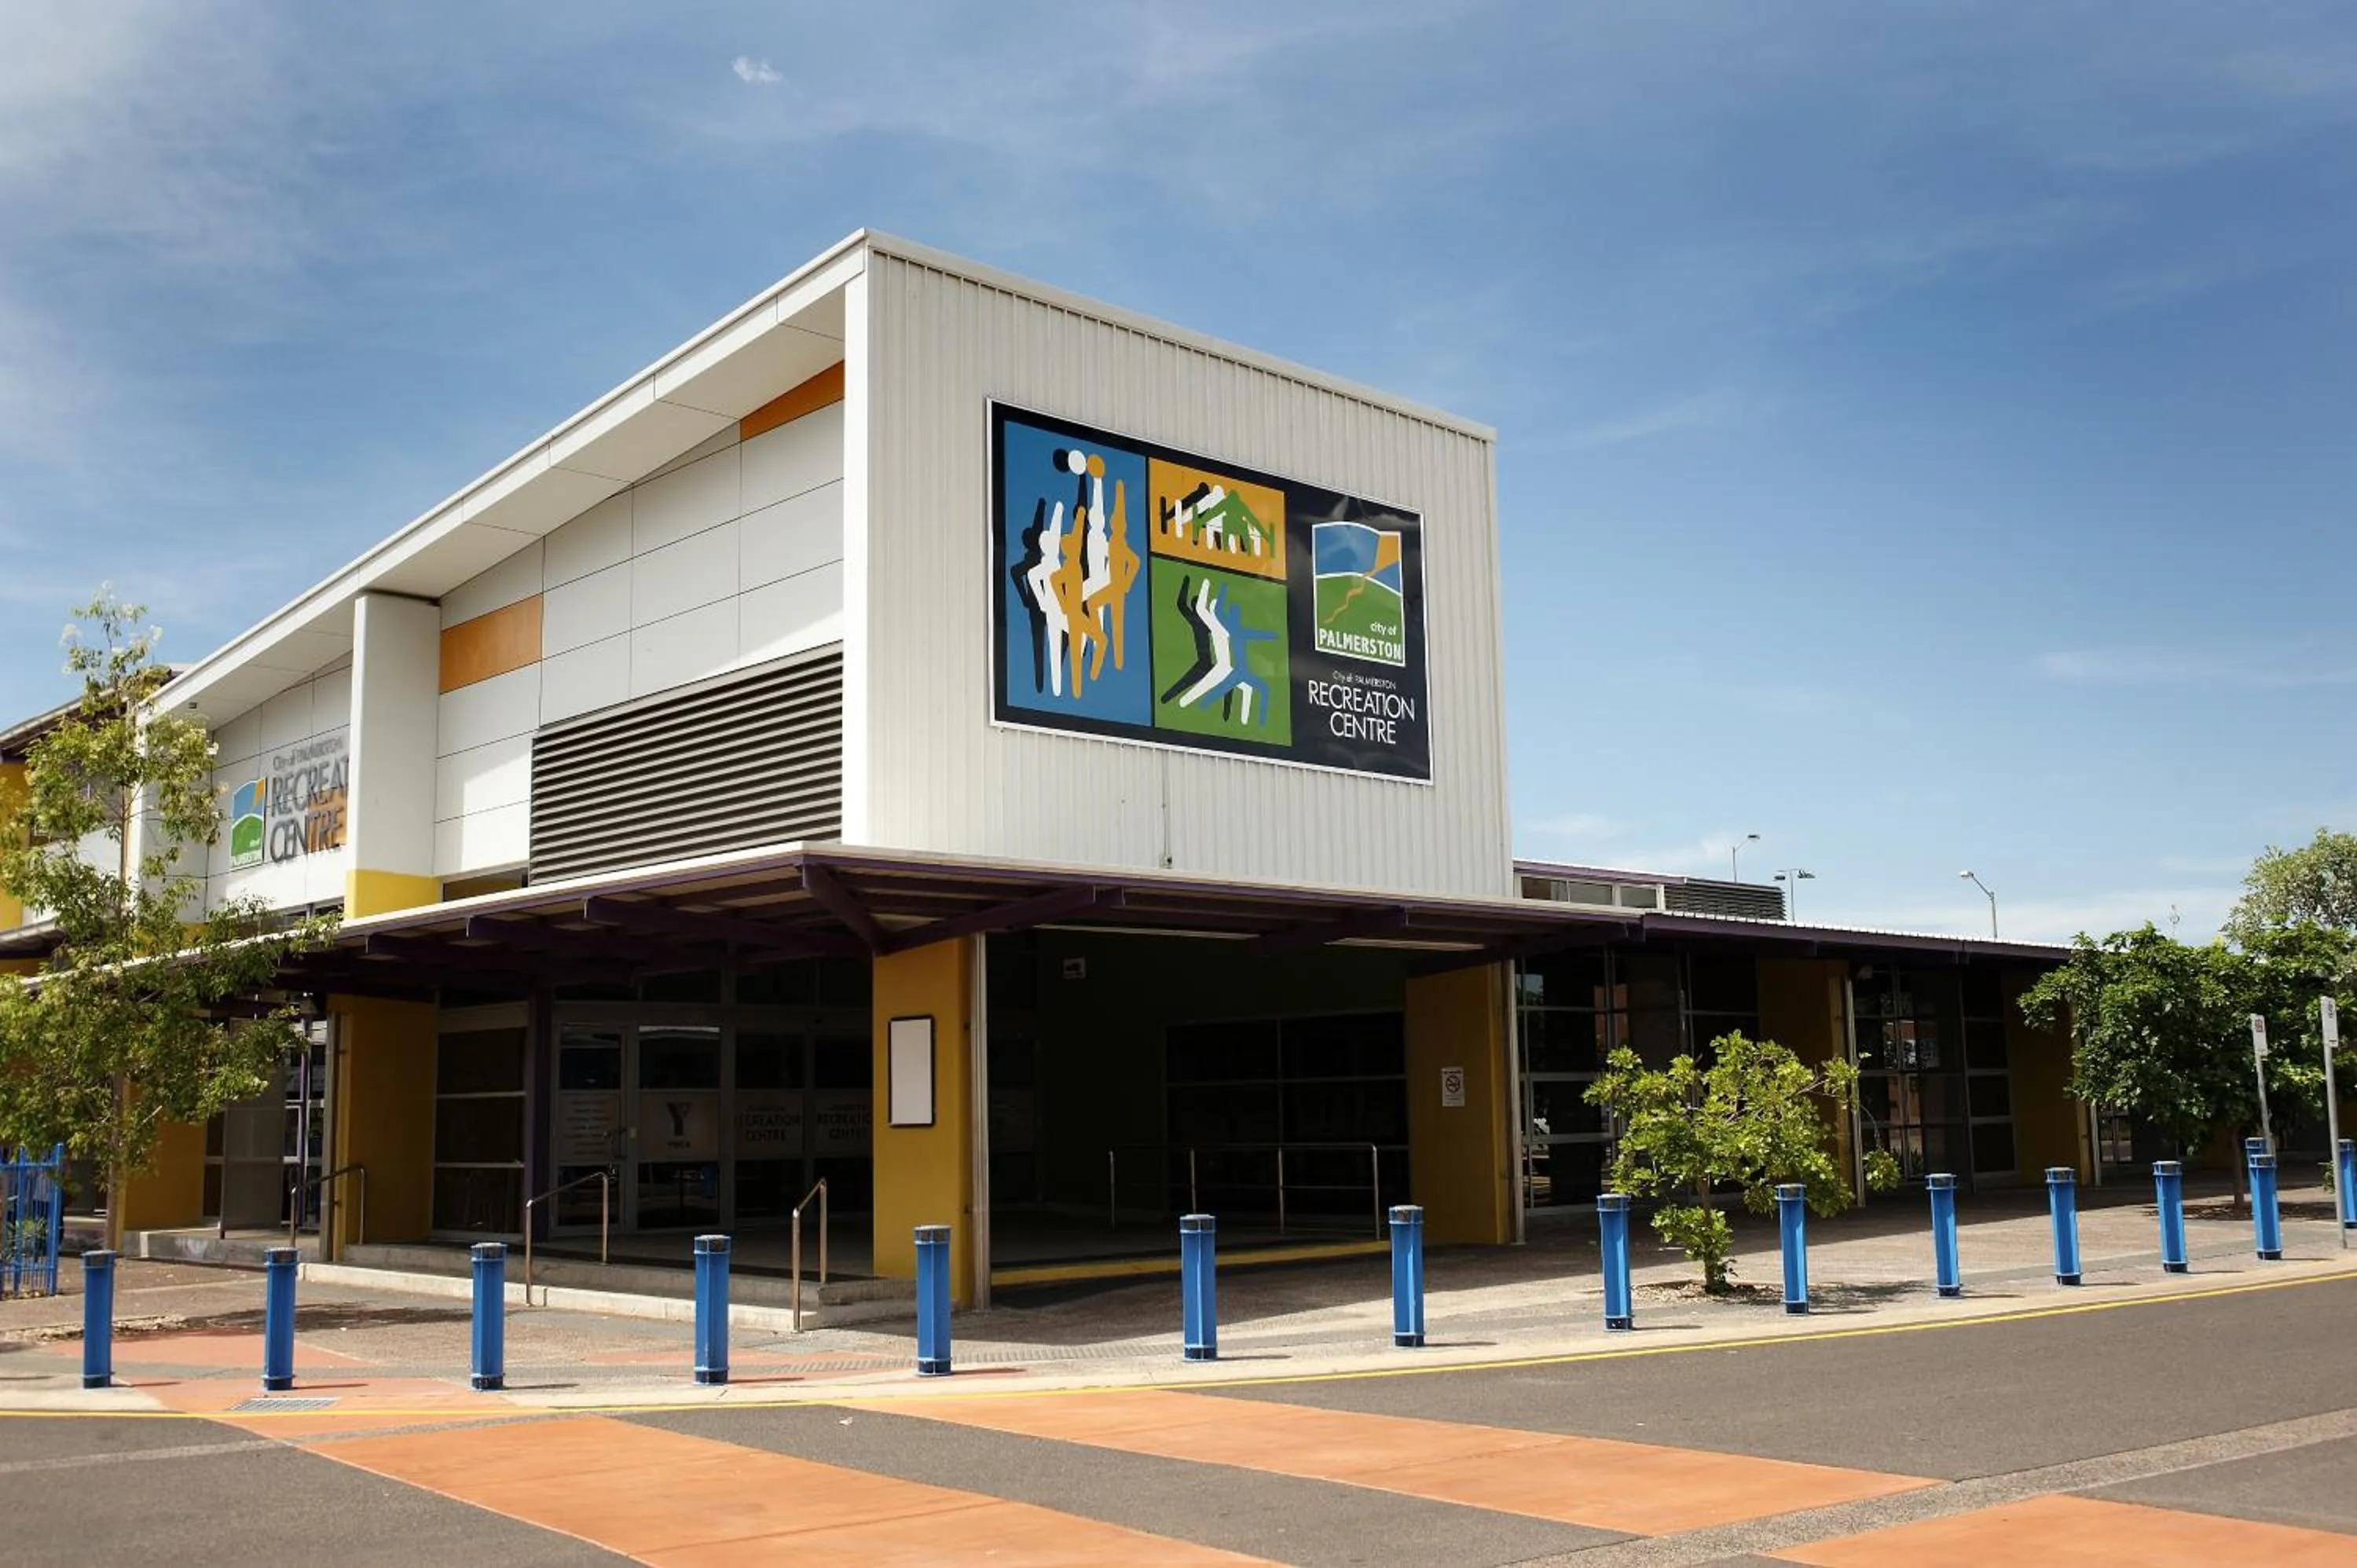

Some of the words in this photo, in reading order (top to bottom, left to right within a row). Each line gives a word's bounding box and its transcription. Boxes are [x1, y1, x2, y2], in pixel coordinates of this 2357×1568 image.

[1319, 628, 1402, 661] PALMERSTON
[1370, 621, 1387, 635] city
[1387, 625, 1397, 636] of
[1354, 674, 1397, 691] PALMERSTON
[1308, 679, 1415, 722] RECREATION
[1329, 711, 1397, 745] CENTRE
[269, 806, 345, 863] CENTRE
